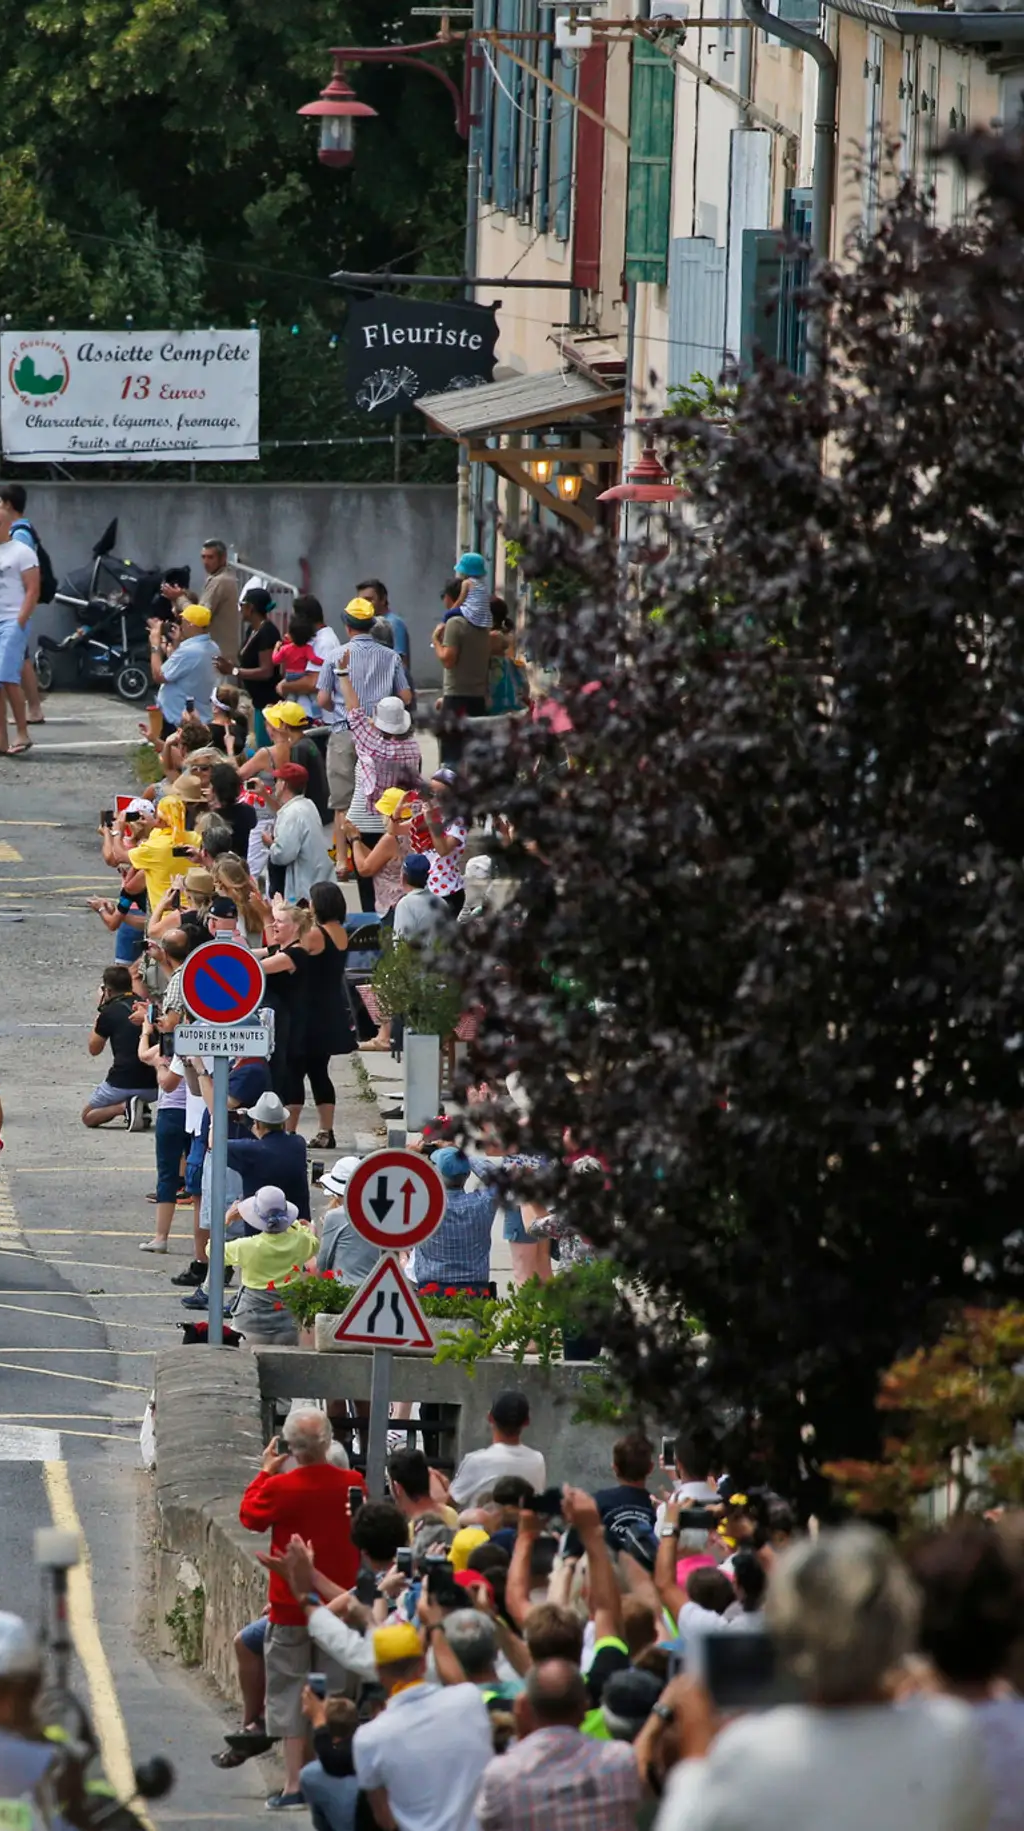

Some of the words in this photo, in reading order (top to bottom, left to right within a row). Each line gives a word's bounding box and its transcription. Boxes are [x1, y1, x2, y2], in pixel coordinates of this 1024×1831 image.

[361, 321, 483, 350] Fleuriste
[77, 342, 153, 362] Assiette
[160, 342, 251, 366] Complète
[121, 374, 151, 400] 13
[159, 384, 207, 400] Euros
[25, 414, 109, 429] Charcuterie,
[112, 414, 173, 431] légumes,
[177, 413, 241, 431] fromage,
[67, 435, 110, 449] Fruits
[114, 436, 127, 449] et
[179, 1029, 217, 1040] AUTORISÉ
[219, 1030, 227, 1040] 15
[229, 1030, 265, 1040] MINUTES
[198, 1043, 208, 1051] DE
[230, 1043, 245, 1052] 19H
